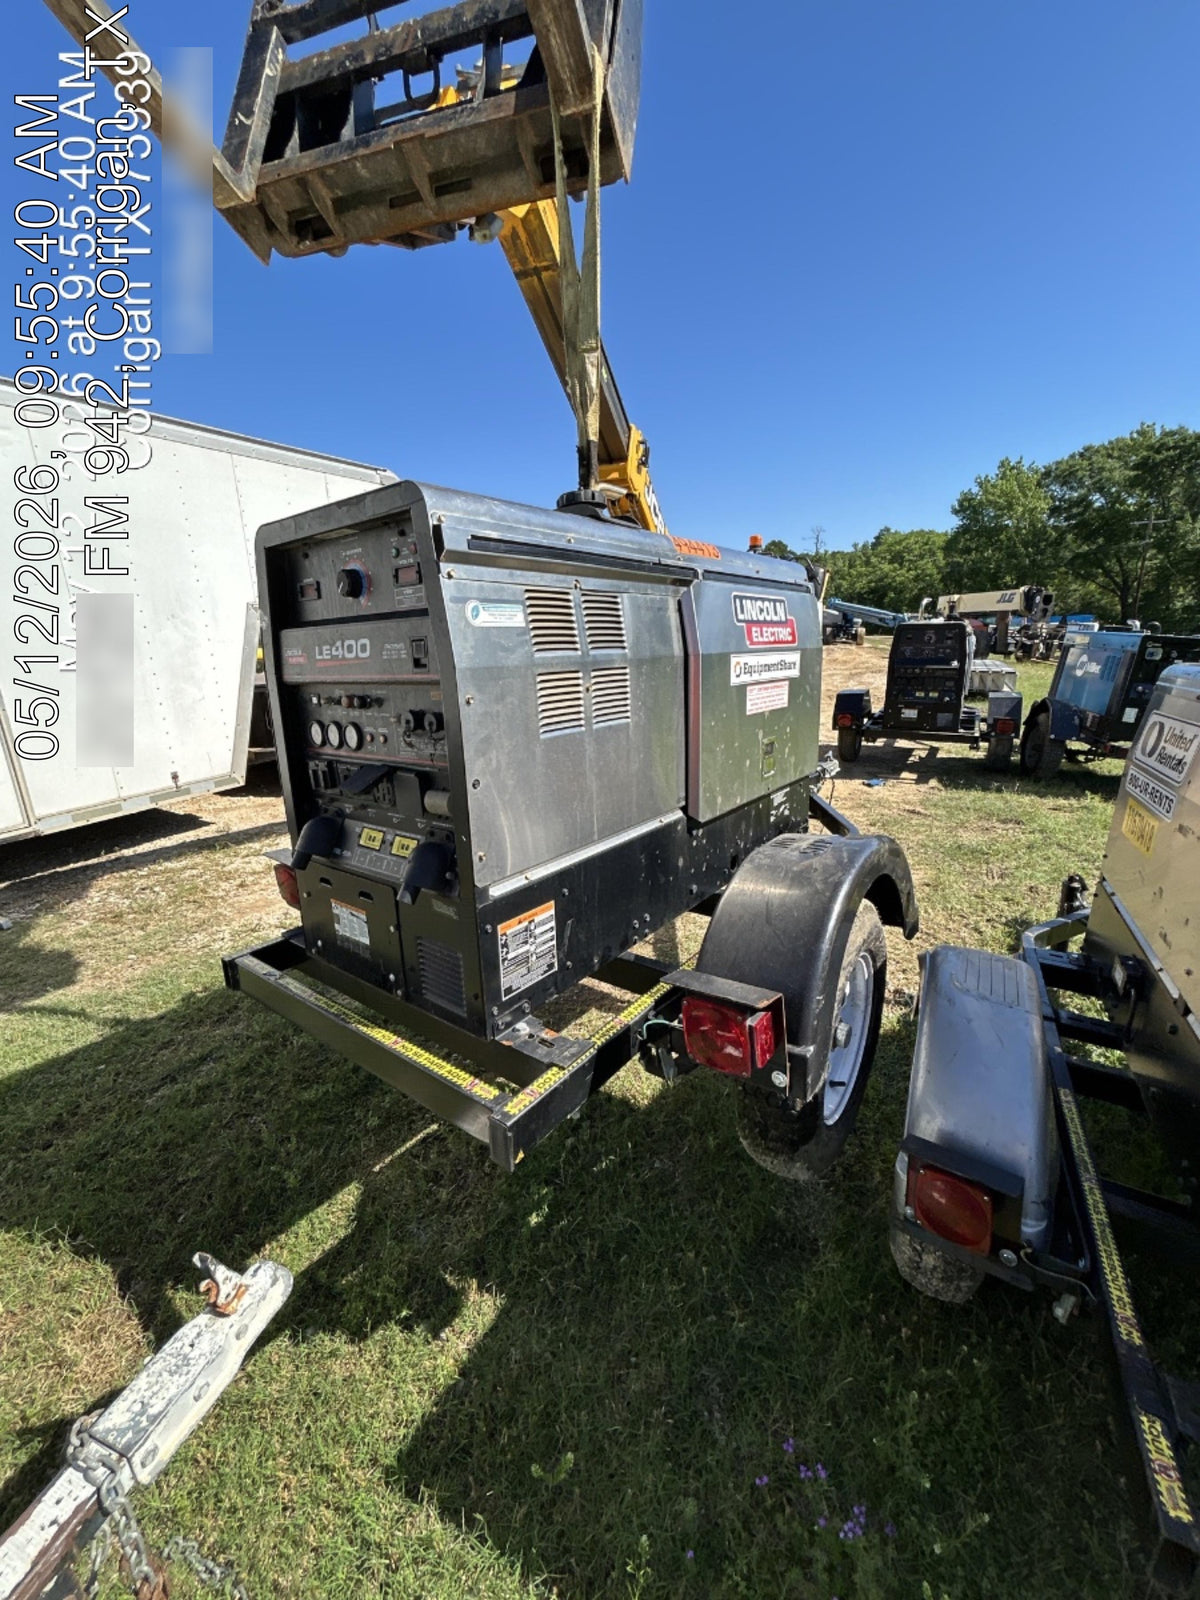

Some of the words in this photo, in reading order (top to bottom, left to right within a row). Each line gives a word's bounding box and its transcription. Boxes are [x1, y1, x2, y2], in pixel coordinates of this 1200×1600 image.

[735, 597, 786, 622] LINCOLN
[997, 592, 1017, 604] JLG
[751, 626, 793, 643] ELECTRIC
[315, 639, 370, 660] LE400
[743, 659, 797, 678] EquipmentShare
[1163, 725, 1197, 753] United
[1154, 745, 1188, 776] Rentals
[1127, 771, 1175, 815] 800-UR-RENTS
